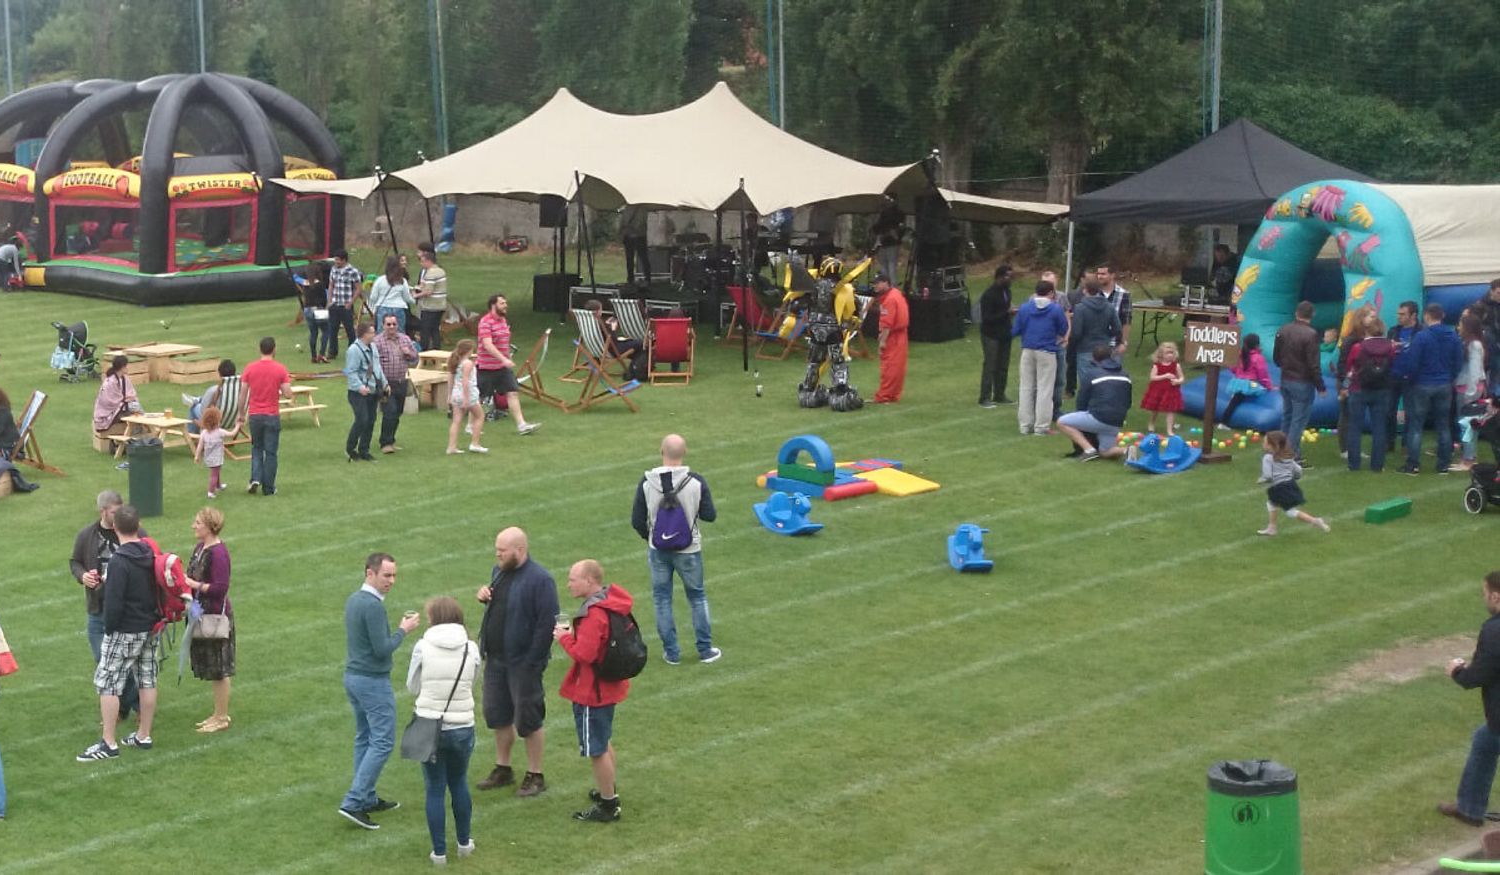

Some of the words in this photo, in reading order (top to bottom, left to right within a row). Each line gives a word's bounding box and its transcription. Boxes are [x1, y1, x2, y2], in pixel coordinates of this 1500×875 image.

[64, 171, 115, 187] FOOTBALL
[188, 179, 242, 190] TWISTER
[1188, 325, 1238, 346] Toddlers
[1195, 344, 1224, 363] Area
